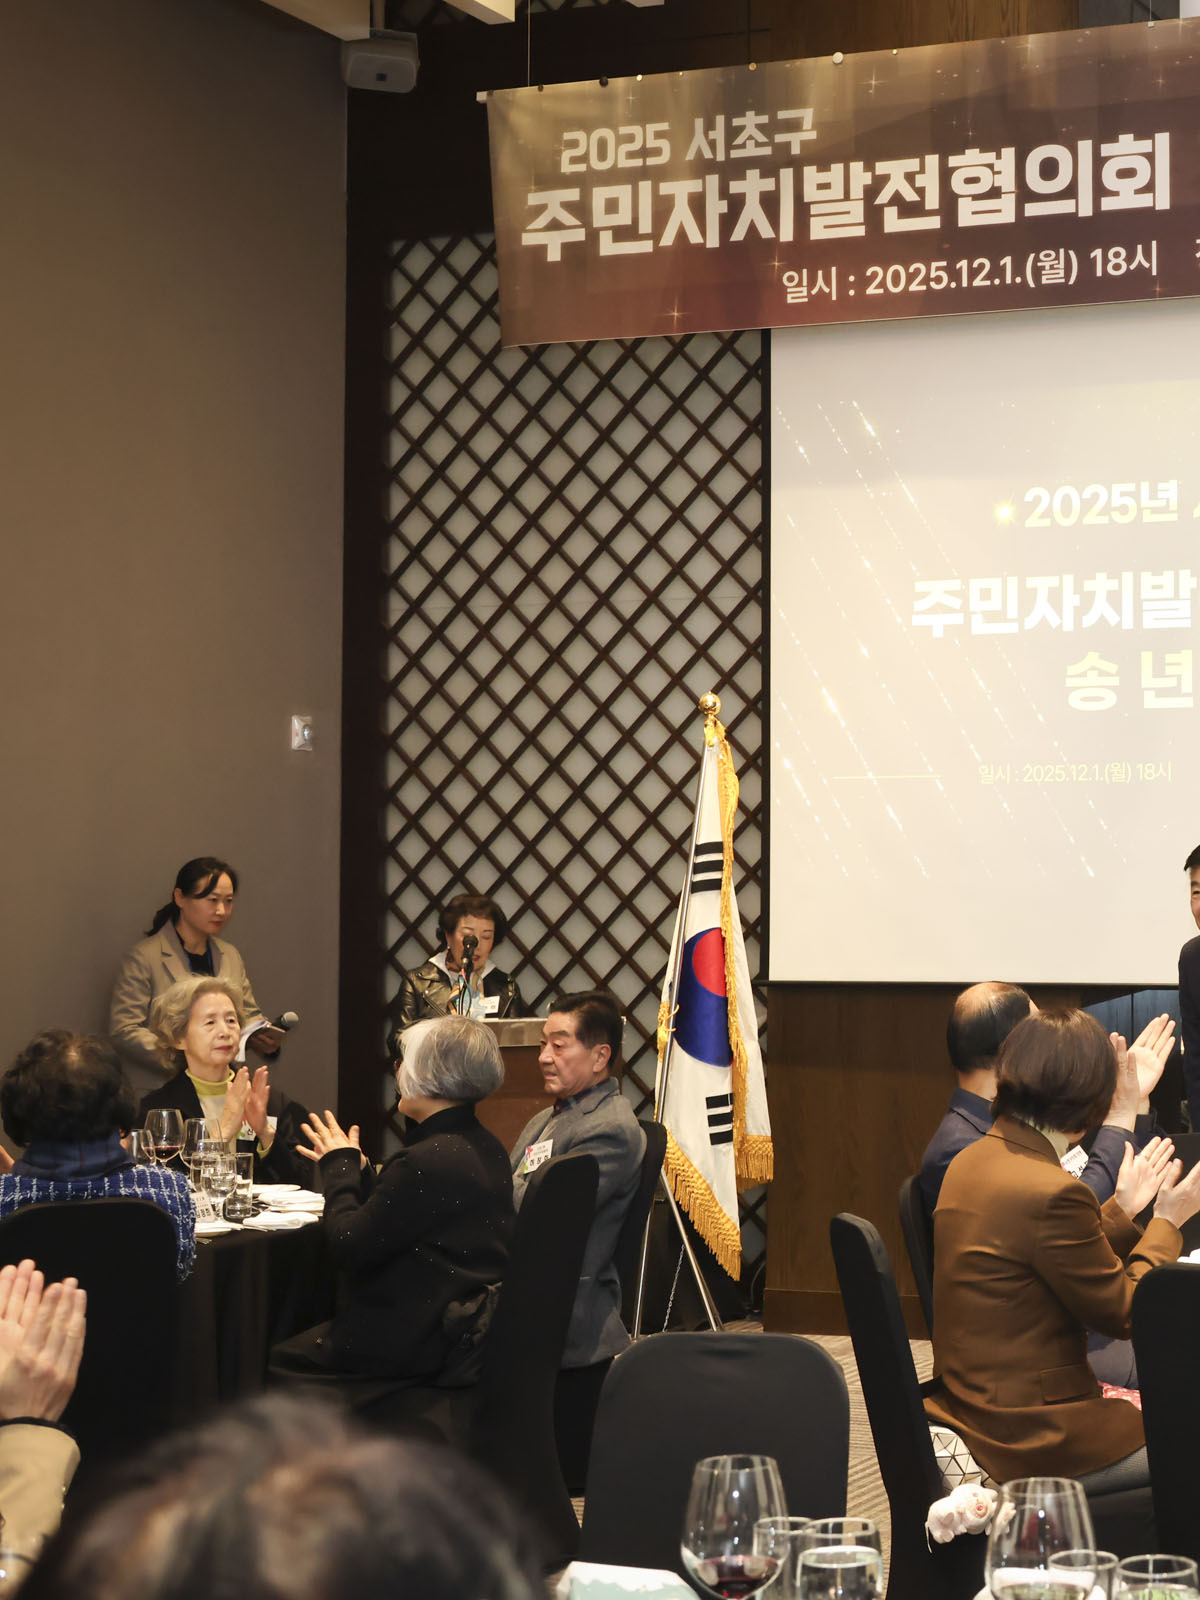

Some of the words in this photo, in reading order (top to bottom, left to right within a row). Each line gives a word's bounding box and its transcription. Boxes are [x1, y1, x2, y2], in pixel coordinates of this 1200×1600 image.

[561, 122, 671, 173] 2025
[685, 108, 817, 162] 서초구
[521, 132, 1172, 262] 주민자치발전협의회
[782, 266, 838, 304] 일시
[865, 247, 1078, 297] 2025.12.1.(월)
[1090, 240, 1159, 280] 18시
[1024, 480, 1179, 528] 2025년
[978, 764, 1011, 785] 일시
[1136, 761, 1172, 781] 18시
